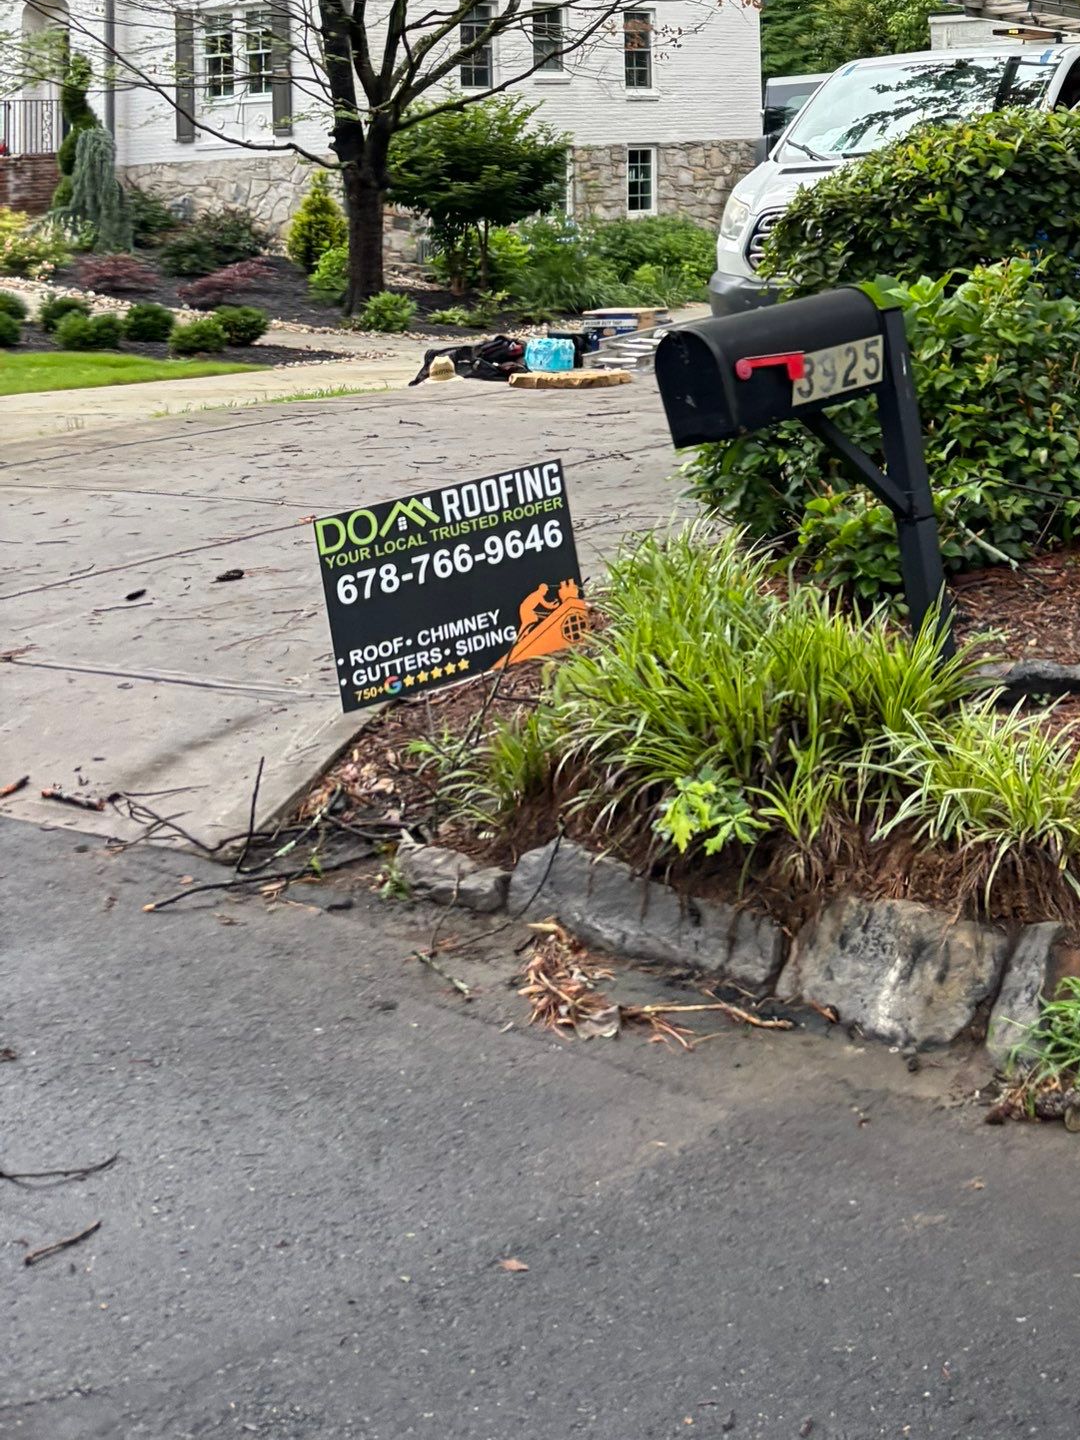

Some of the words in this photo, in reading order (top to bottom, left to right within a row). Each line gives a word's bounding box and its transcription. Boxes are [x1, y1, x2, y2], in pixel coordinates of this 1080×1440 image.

[797, 339, 880, 398] 3925
[441, 463, 562, 523] ROOFING
[325, 546, 371, 569] YOUR
[375, 533, 428, 557] LOCAL
[429, 514, 499, 542] TRUSTED
[503, 497, 564, 523] ROOFER
[336, 520, 563, 605] 678-766-9646
[349, 637, 404, 667] ROOF
[417, 609, 500, 647] CHIMNEY
[352, 647, 443, 686] GUTTERS
[455, 625, 518, 656] SIDING
